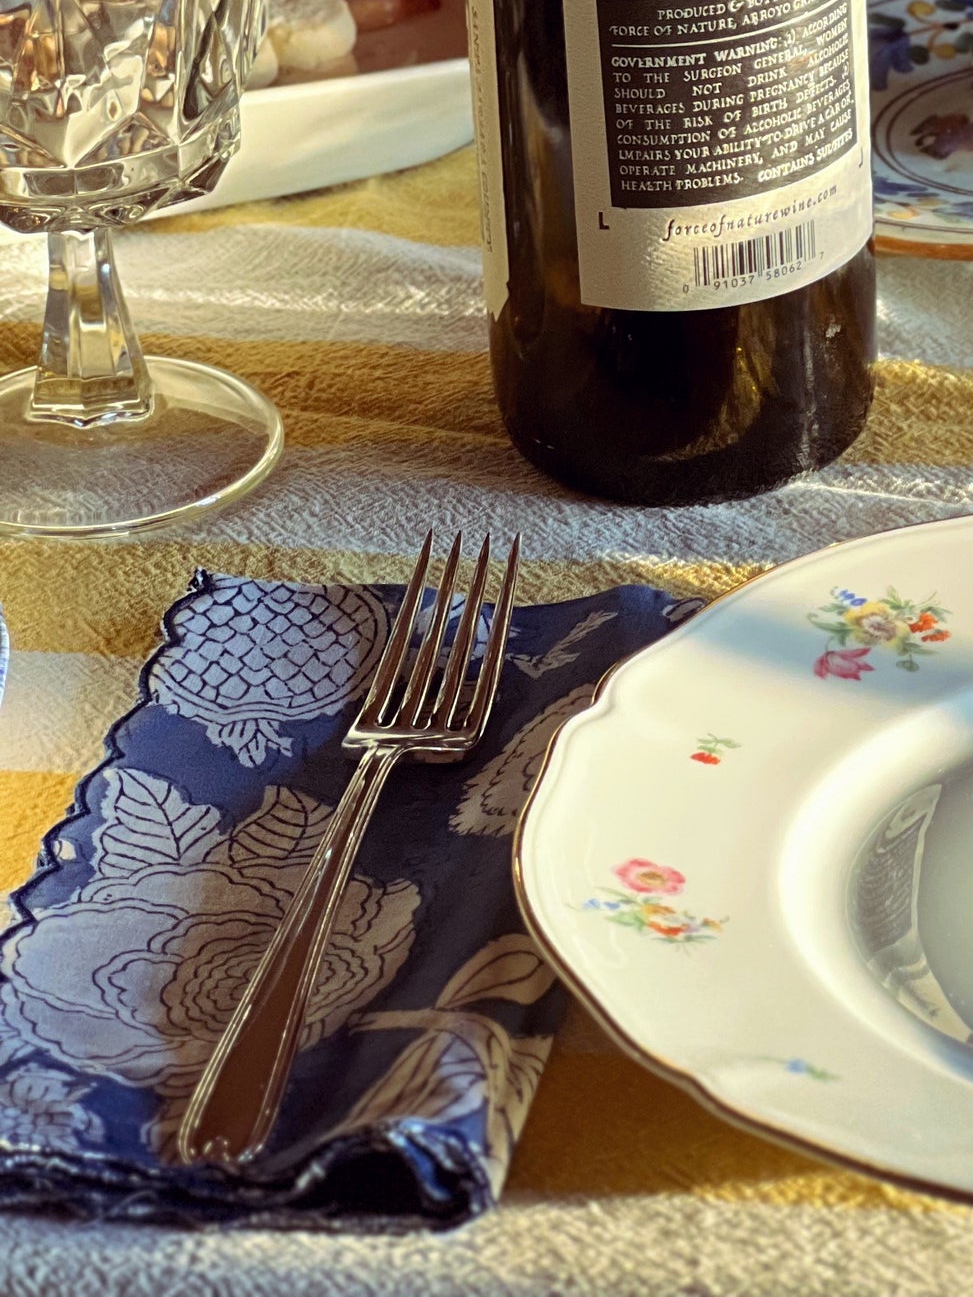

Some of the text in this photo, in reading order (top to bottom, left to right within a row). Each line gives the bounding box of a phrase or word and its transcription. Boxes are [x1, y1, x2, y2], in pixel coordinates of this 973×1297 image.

[609, 25, 650, 36] FORCE
[653, 25, 672, 36] OF
[677, 17, 738, 35] NATURE,
[742, 2, 791, 26] ARROYO
[611, 53, 707, 68] GOVERNMENT
[713, 37, 781, 62] WARNING:
[801, 2, 848, 39] ACCORDING
[657, 3, 726, 20] PRODUCED
[613, 72, 631, 83] TO
[642, 72, 671, 84] THE
[683, 63, 742, 82] SURGEON
[816, 17, 848, 46] WOMEN
[614, 87, 666, 99] SHOULD
[691, 82, 723, 97] NOT
[747, 66, 788, 88] DRINK
[615, 48, 849, 114] BEVERAGES DURING PREGNANCY BECAUSE
[615, 119, 634, 129] OF
[644, 119, 672, 131] THE
[682, 115, 713, 129] RISK
[723, 109, 742, 123] OF
[752, 97, 788, 118] BIRTH
[617, 79, 851, 146] CONSUMPTION OF ALCOHOLIC BEVERAGES
[619, 149, 671, 161] IMPAIRS
[674, 146, 711, 160] YOUR
[713, 136, 761, 156] ABILITY
[765, 131, 782, 145] TO
[784, 117, 816, 139] DRIVE
[817, 113, 825, 125] A
[825, 102, 841, 120] CAR
[619, 108, 852, 176] OPERATE MACHINERY, AND MAY CAUSE
[621, 180, 673, 192] HEALTH
[675, 172, 744, 191] PROBLEMS.
[757, 152, 815, 183] CONTAINS
[662, 184, 837, 242] forceofnaturewine.com
[682, 251, 825, 294] 0 91037 58062 7
